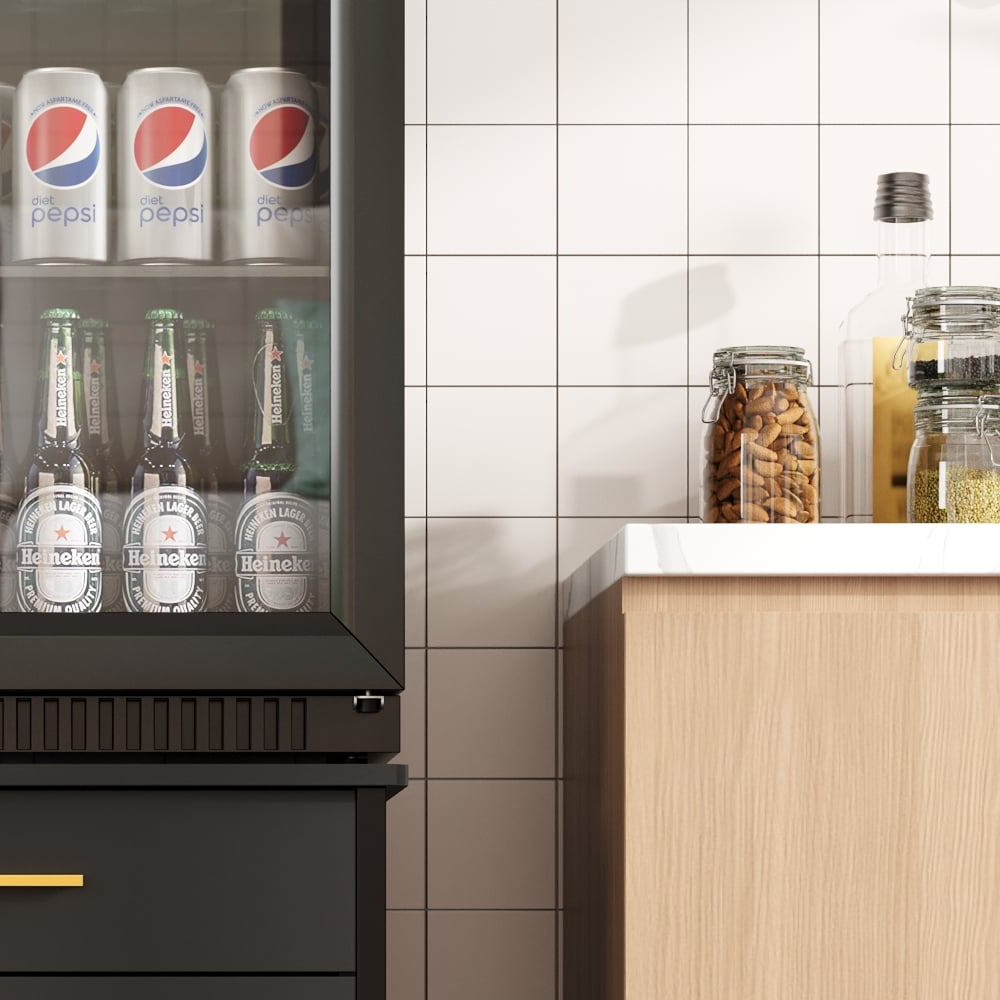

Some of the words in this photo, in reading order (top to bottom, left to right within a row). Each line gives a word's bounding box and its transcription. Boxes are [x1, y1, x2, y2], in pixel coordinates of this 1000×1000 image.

[32, 195, 55, 205] diet
[140, 195, 163, 205] diet
[257, 194, 281, 205] diet
[31, 204, 96, 227] pepsi
[139, 204, 203, 227] pepsi
[56, 368, 67, 427] Heineken
[161, 369, 173, 428] Heineken
[271, 364, 282, 424] Heineken
[24, 501, 57, 534] HEINEKEN
[58, 501, 87, 516] LAGER
[84, 512, 98, 535] BEER
[131, 502, 165, 535] HEINEKEN
[166, 501, 195, 517] LAGER
[192, 513, 205, 536] BEER
[244, 508, 277, 542] HEINEKEN
[279, 507, 306, 523] LAGER
[21, 549, 100, 566] Heineken
[128, 550, 207, 566] Heineken
[65, 585, 97, 612] QUALITY
[173, 586, 204, 612] QUALITY
